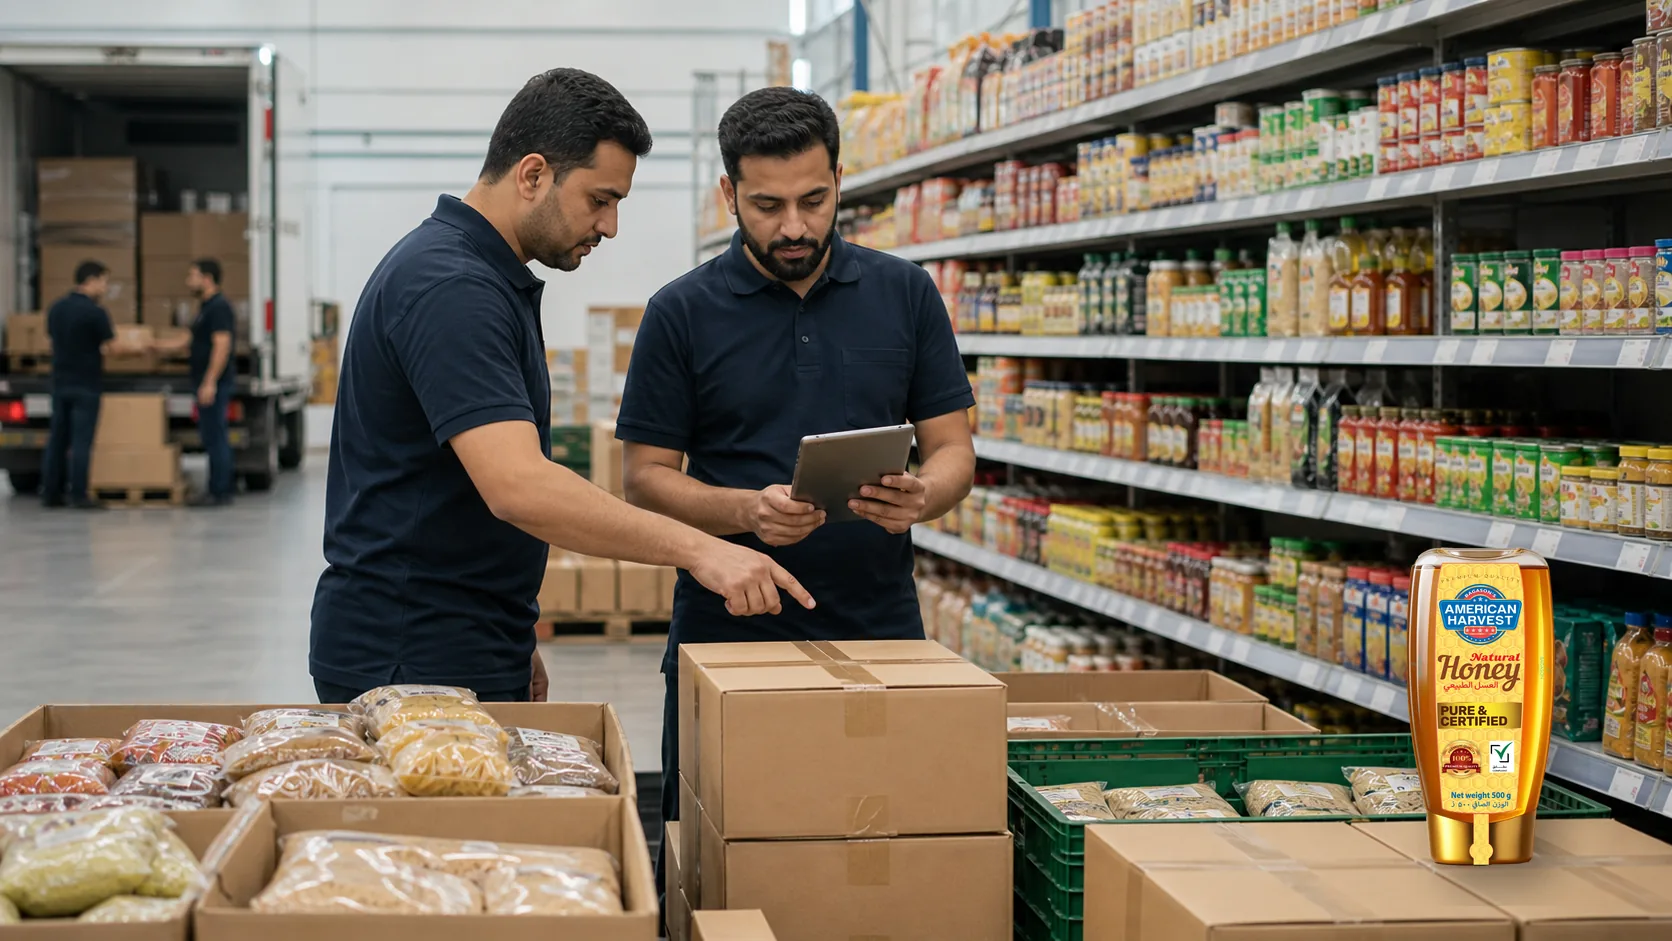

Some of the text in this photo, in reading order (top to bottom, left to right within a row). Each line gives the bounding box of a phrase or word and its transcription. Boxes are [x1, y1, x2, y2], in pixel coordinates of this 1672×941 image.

[1484, 574, 1520, 583] QUALITY
[1464, 588, 1497, 598] BAGASON'S
[1445, 604, 1516, 614] AMERICAN
[1447, 615, 1513, 626] HARVEST
[1470, 652, 1521, 662] Natural
[1437, 654, 1521, 692] Honey
[1443, 681, 1499, 692] العسل الطبيعي
[1440, 705, 1488, 716] PURE &
[1440, 716, 1508, 727] CERTIFIED
[1450, 791, 1464, 799] Net
[1465, 791, 1491, 800] weight
[1491, 791, 1505, 799] 500
